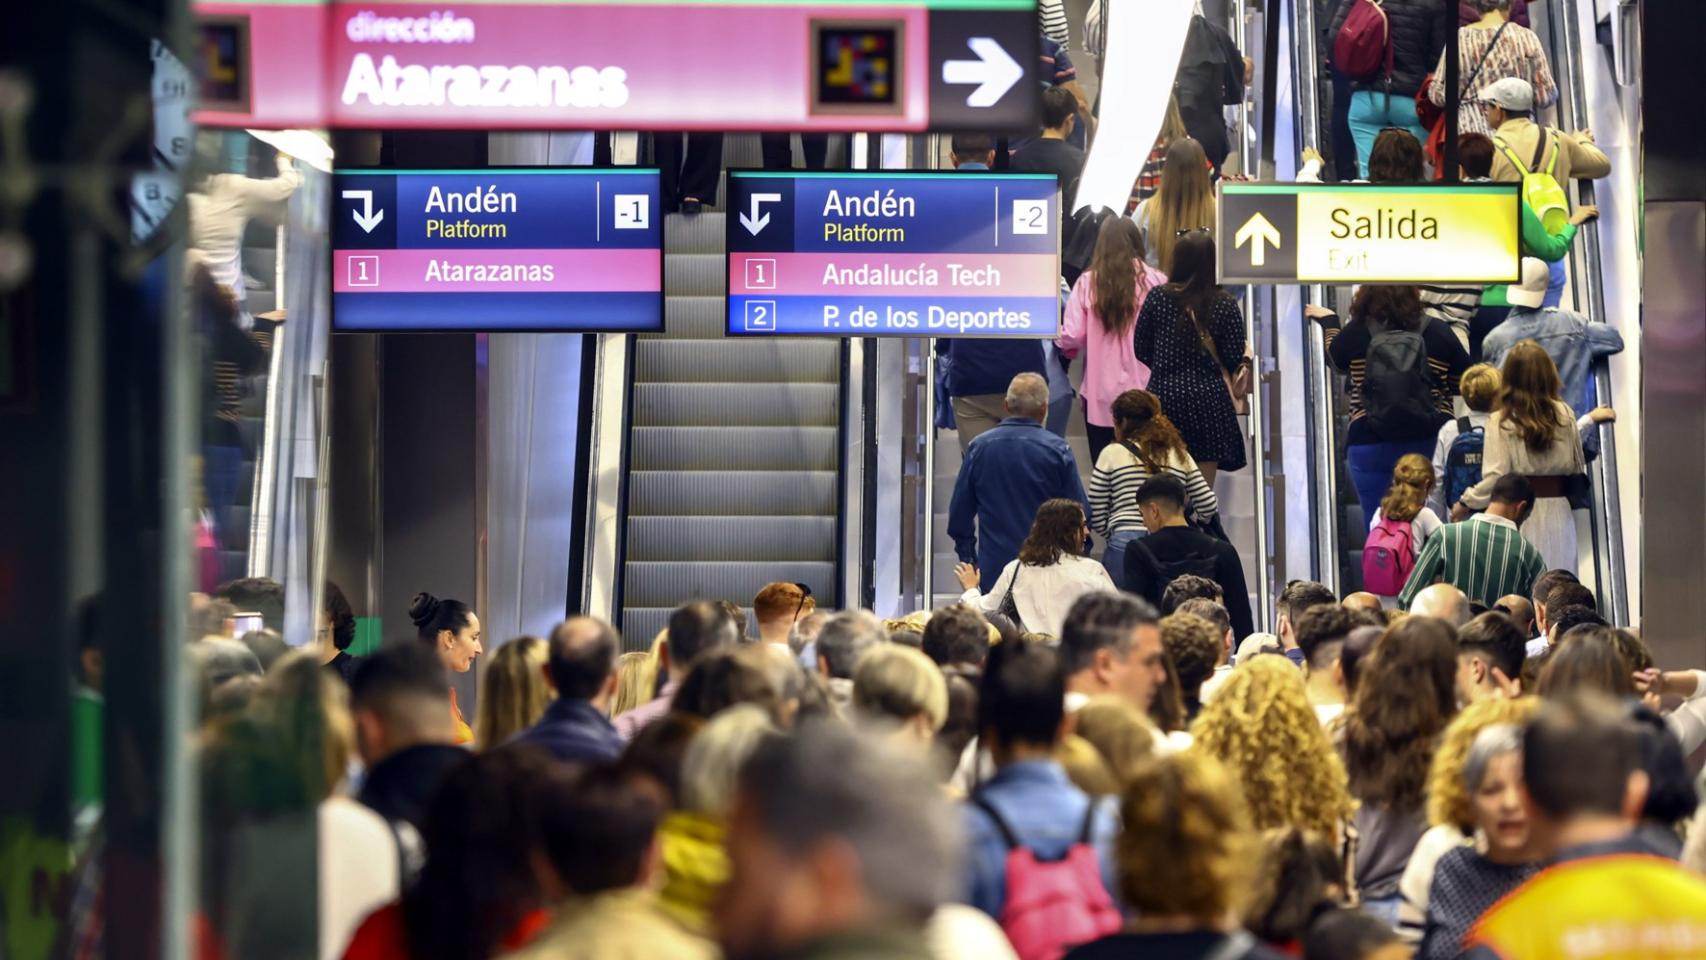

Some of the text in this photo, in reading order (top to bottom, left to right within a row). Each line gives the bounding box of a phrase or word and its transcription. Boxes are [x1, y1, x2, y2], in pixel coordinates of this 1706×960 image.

[347, 12, 476, 43] dirección
[342, 53, 629, 108] Atarazanas
[425, 185, 517, 213] Andén
[823, 188, 915, 217] Andén
[620, 201, 643, 222] -1
[1018, 206, 1043, 229] -2
[426, 219, 507, 239] Platform
[824, 223, 904, 243] Platform
[1330, 208, 1438, 240] Salida
[1329, 249, 1367, 270] Exit
[357, 260, 555, 283] 1 Atarazanas
[755, 264, 1000, 287] 1 Andalucía Tech
[753, 306, 1031, 332] 2 P. de los Deportes
